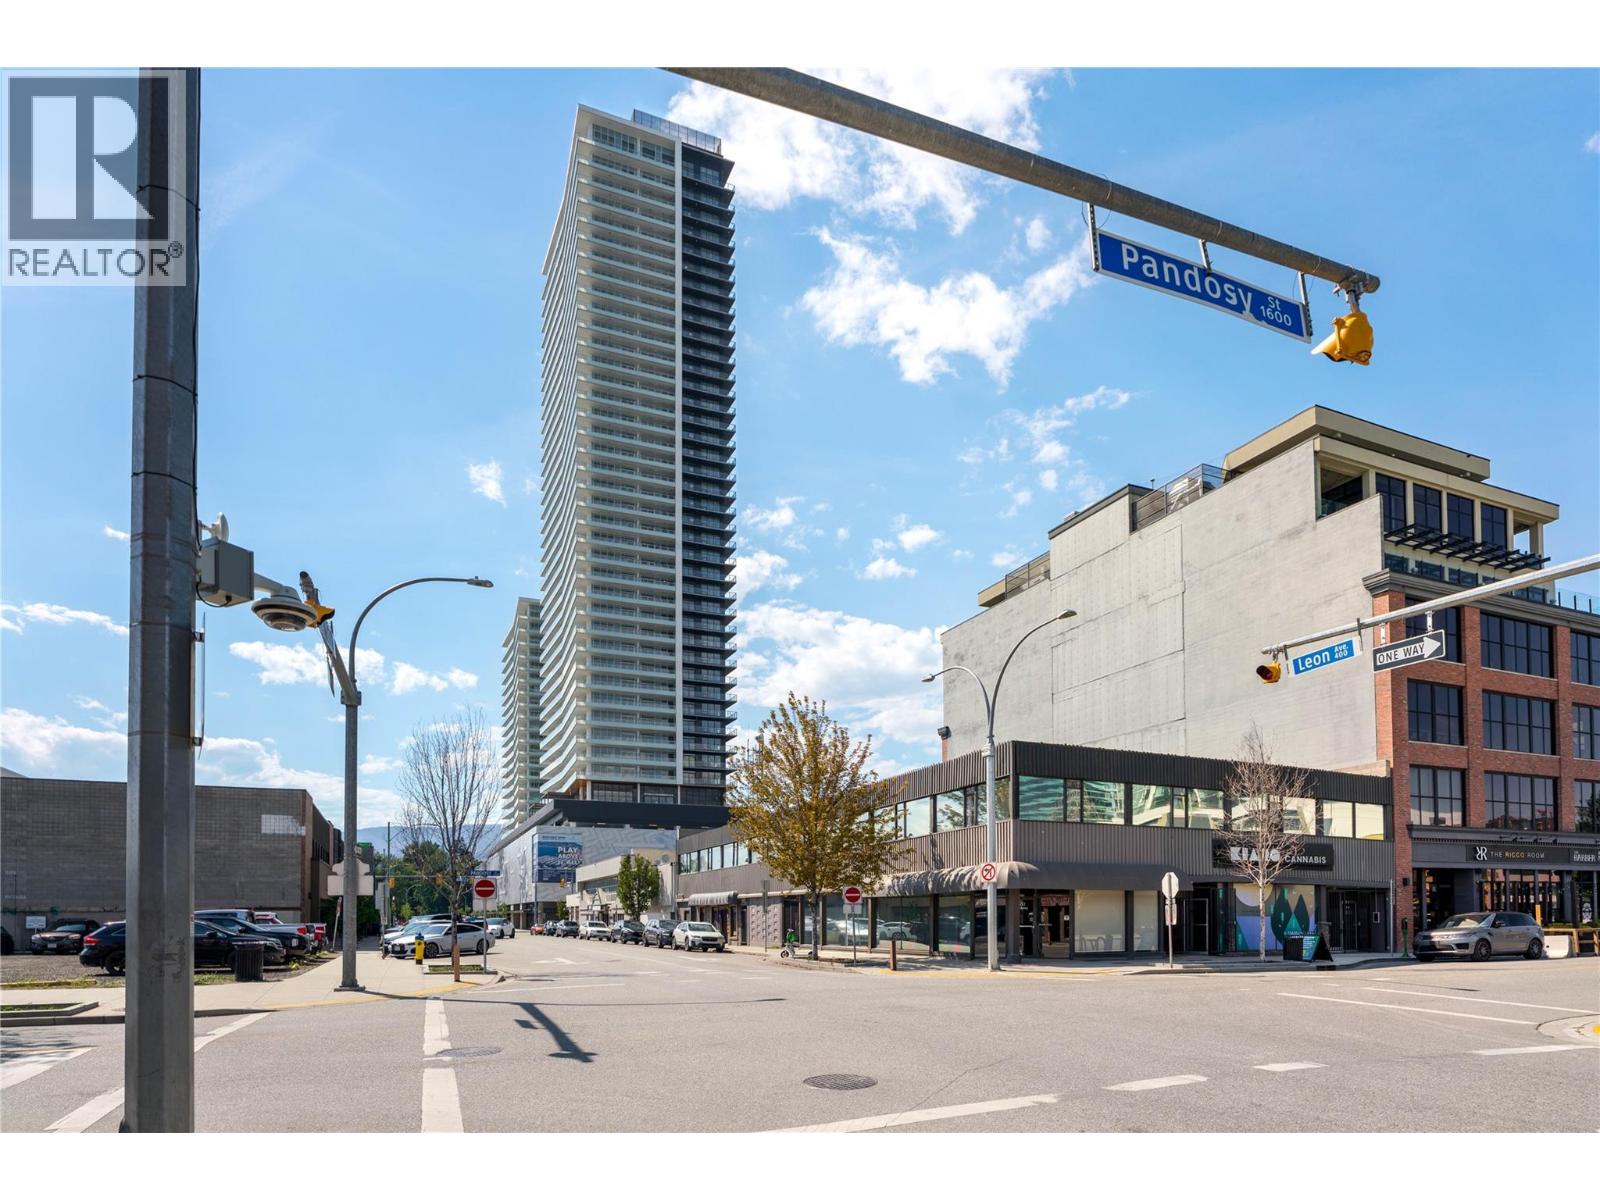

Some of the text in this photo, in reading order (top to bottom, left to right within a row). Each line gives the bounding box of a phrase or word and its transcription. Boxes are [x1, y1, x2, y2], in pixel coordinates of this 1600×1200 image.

[1121, 243, 1252, 314] Pandosy
[1268, 296, 1281, 311] St
[1260, 306, 1292, 327] 1600
[1298, 650, 1331, 671] Leon
[1334, 650, 1348, 659] 400
[1378, 643, 1425, 664] ONE WAY
[1285, 855, 1327, 864] CANNABIS
